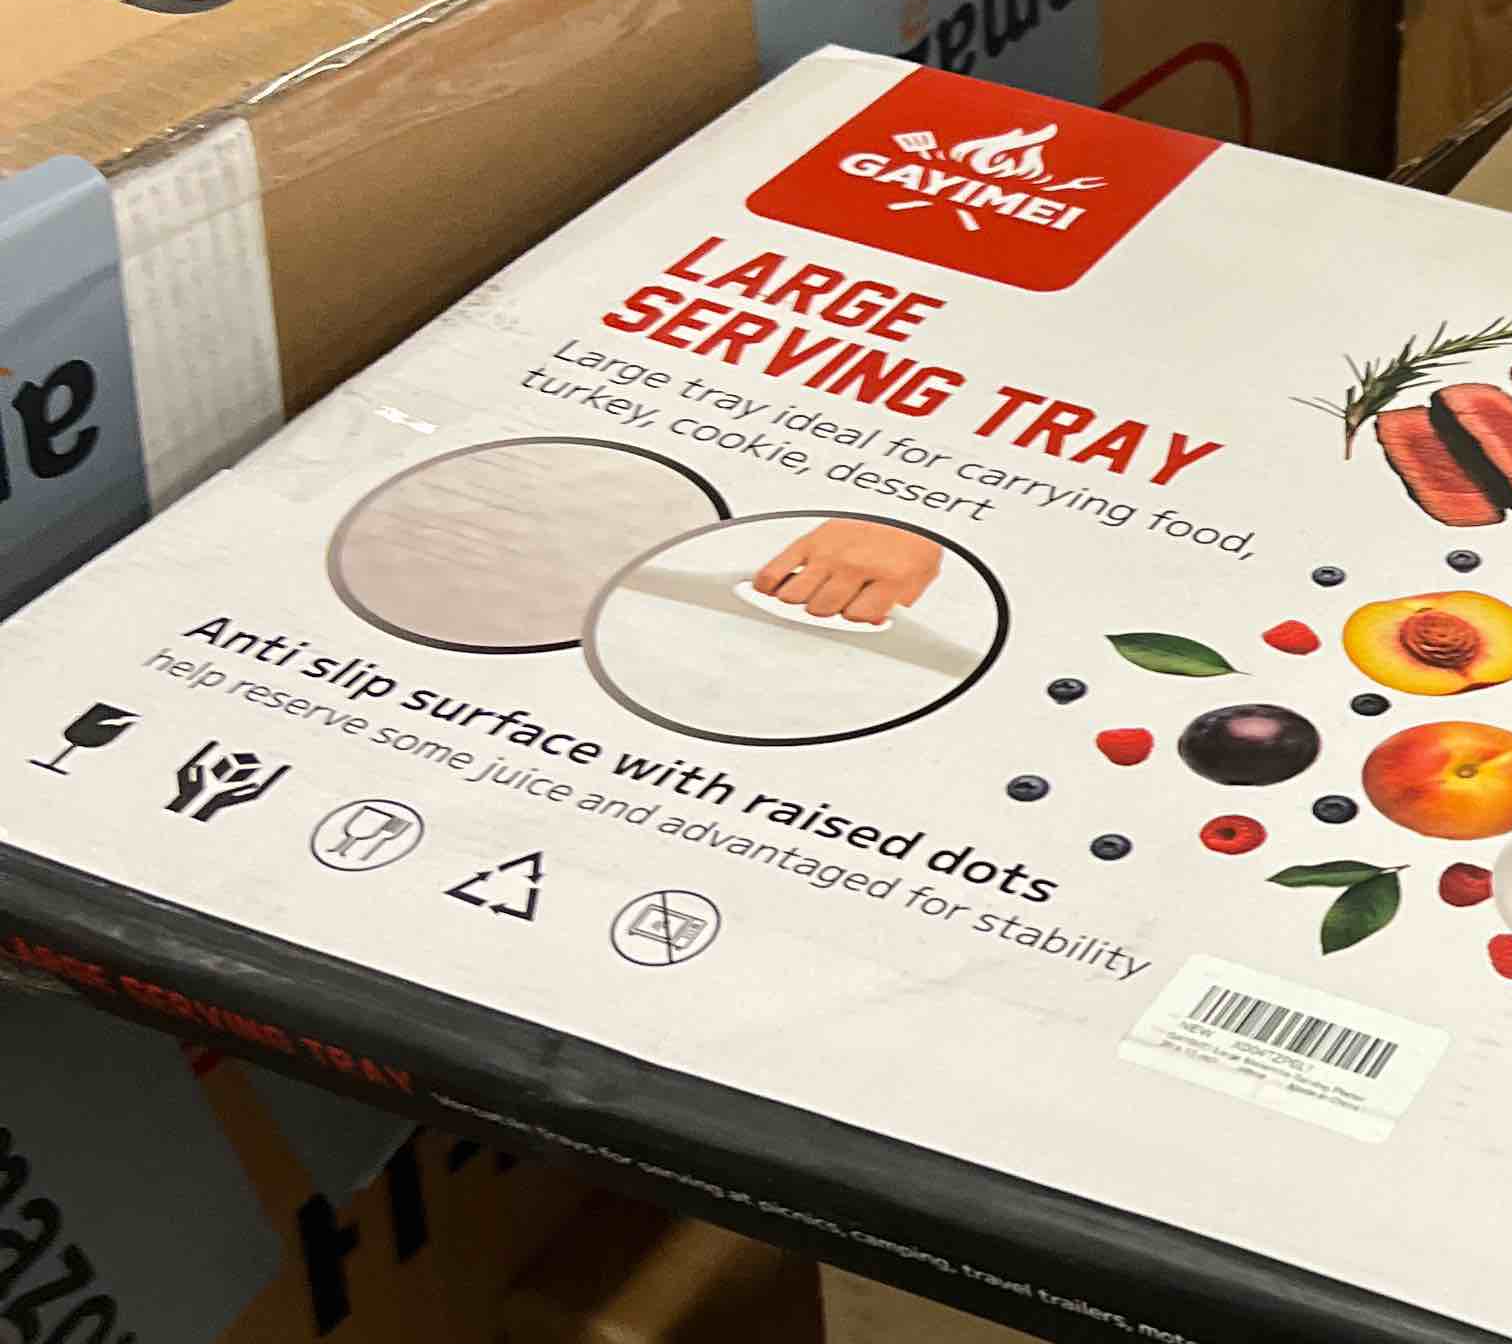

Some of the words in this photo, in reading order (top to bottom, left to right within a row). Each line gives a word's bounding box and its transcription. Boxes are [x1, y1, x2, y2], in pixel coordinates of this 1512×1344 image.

[660, 236, 949, 344] LARGE
[837, 150, 1089, 236] GAYIMEI
[519, 365, 655, 431] turkey,
[669, 414, 813, 479] cookie,
[827, 455, 997, 525] dessert
[551, 338, 673, 392] Large
[679, 375, 769, 422] tray
[770, 397, 885, 451] ideal
[881, 433, 953, 469] for
[955, 458, 1139, 530] carrying
[1144, 507, 1258, 561] food,
[601, 285, 969, 419] SERVING
[975, 385, 1225, 488] TRAY
[141, 646, 226, 692] help
[226, 675, 369, 737] reserve
[376, 727, 475, 771] some
[471, 756, 574, 802] juice
[576, 789, 663, 825] and
[657, 811, 905, 905] advantaged
[902, 886, 971, 922] for
[971, 908, 1154, 983] stability
[181, 616, 307, 667] Anti
[299, 650, 397, 699] slip
[399, 687, 604, 765] surface
[611, 751, 737, 807] with
[740, 789, 927, 862] raised
[926, 845, 1060, 906] dots
